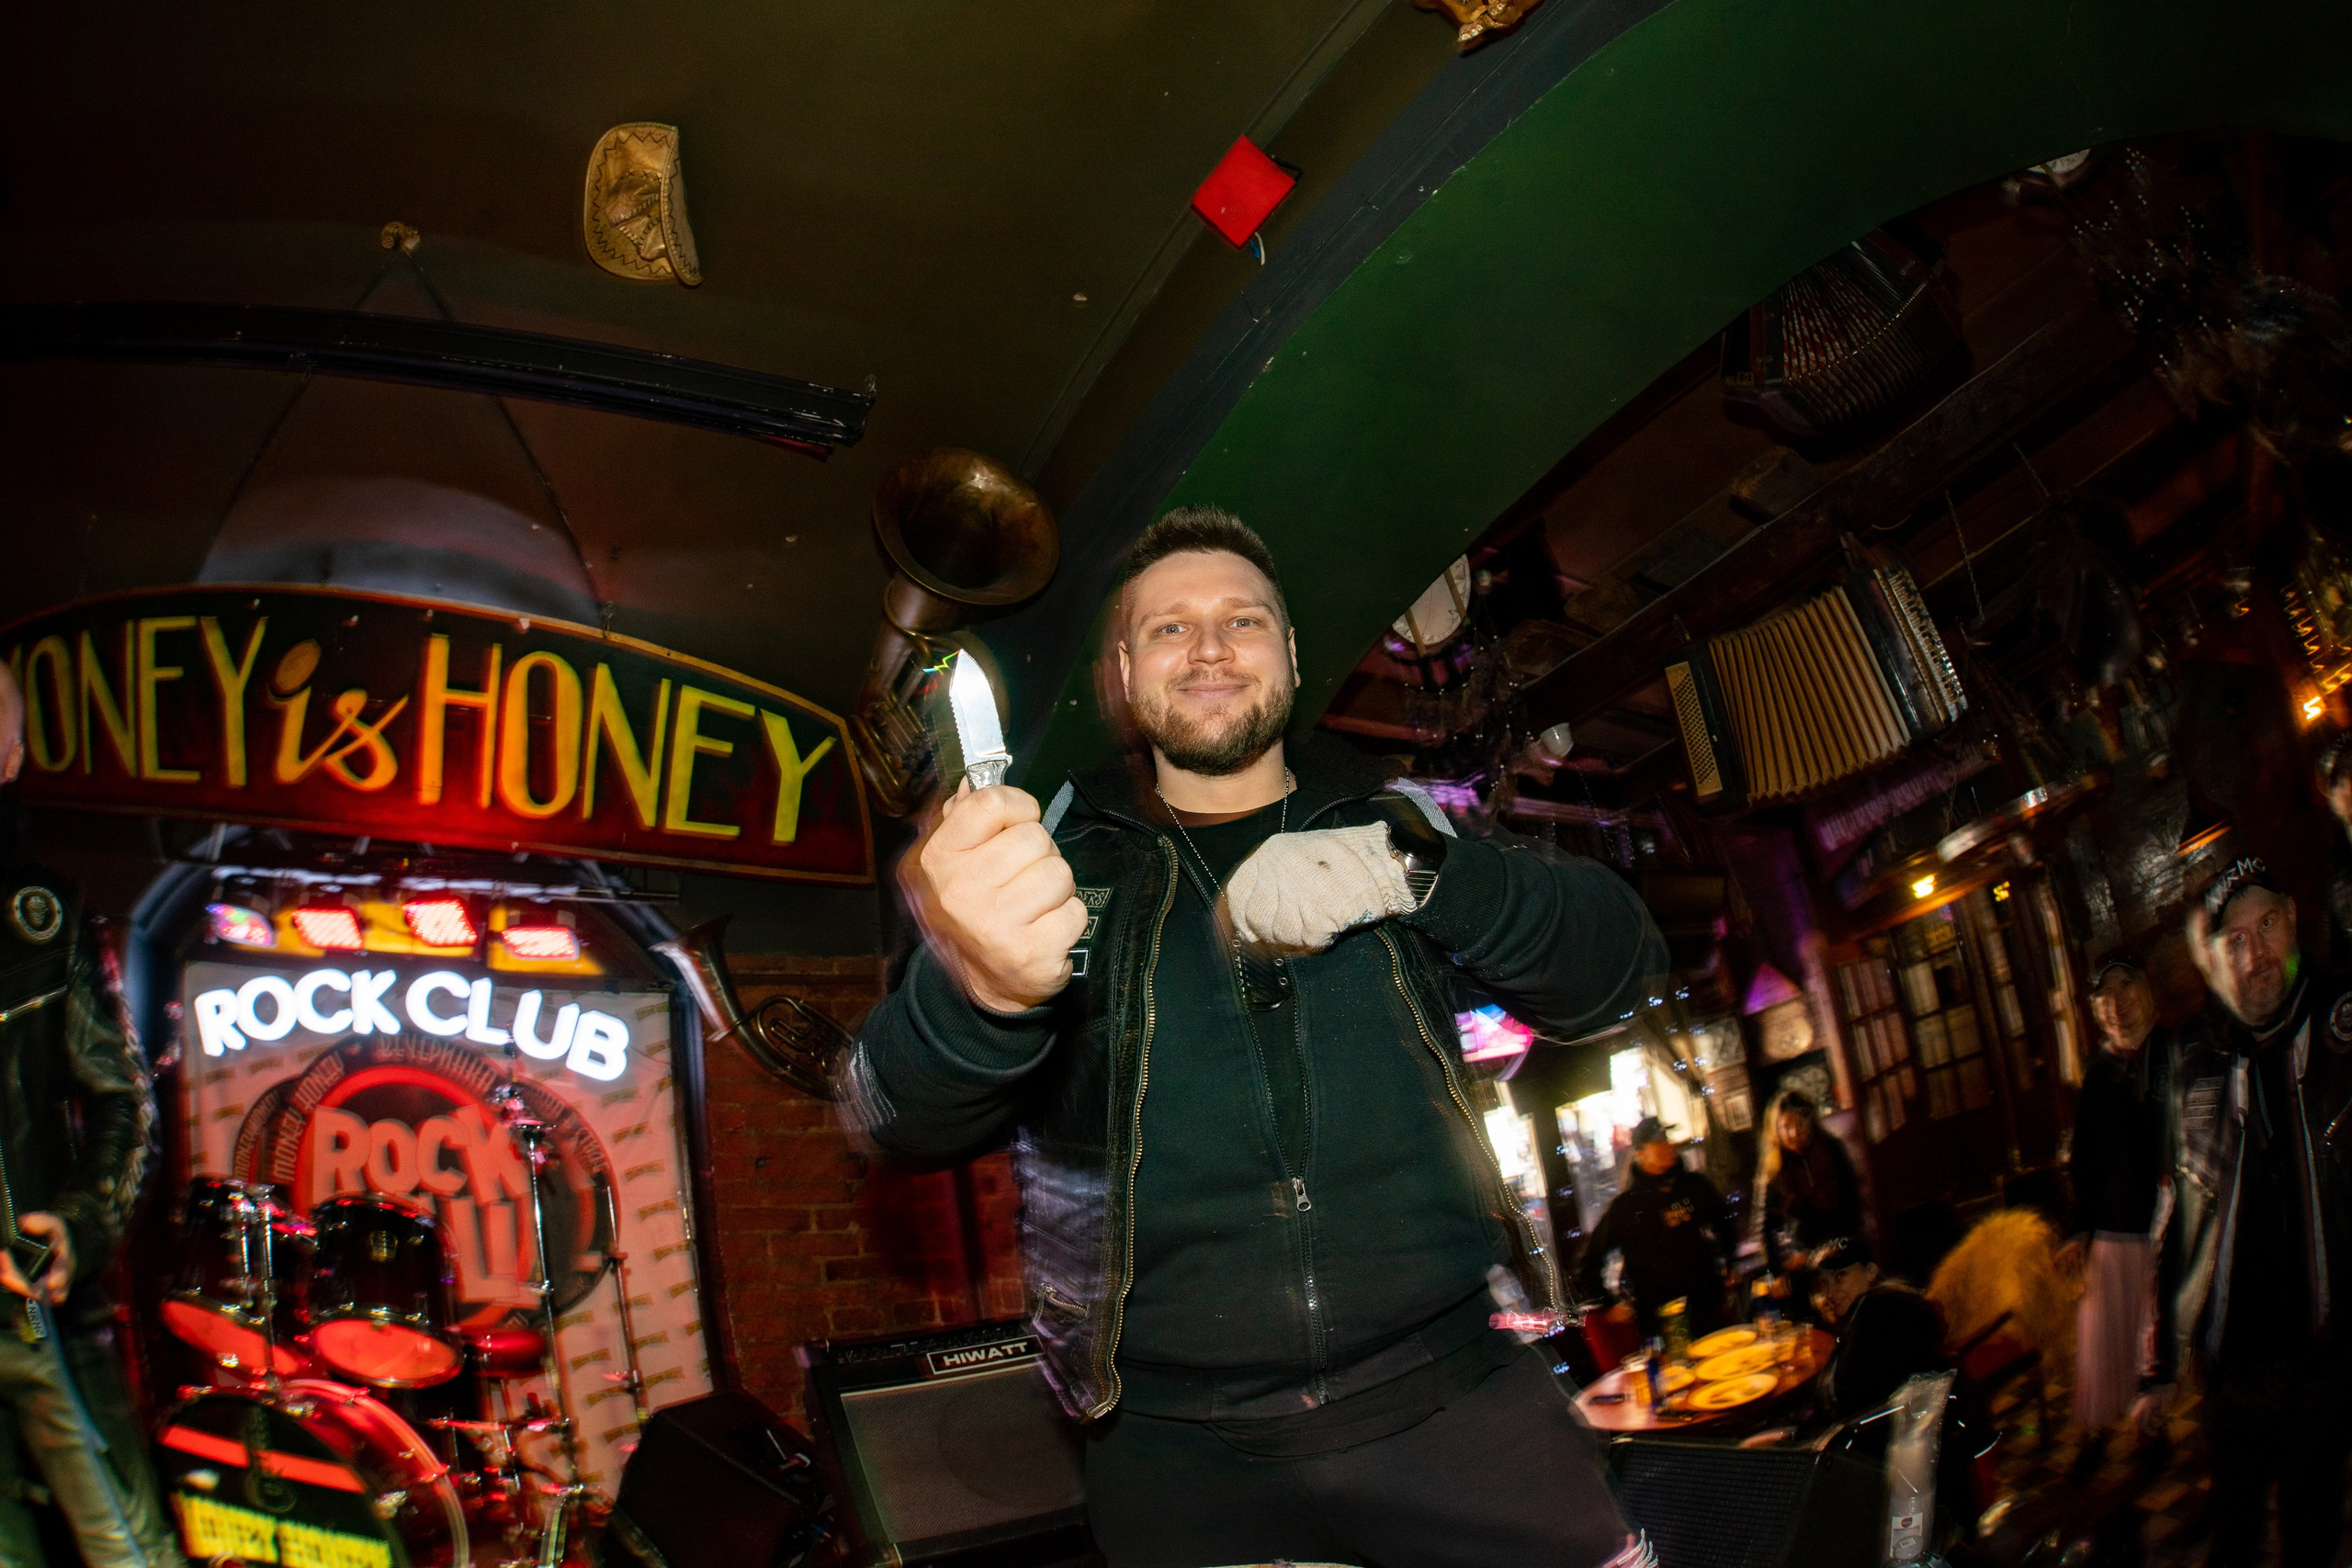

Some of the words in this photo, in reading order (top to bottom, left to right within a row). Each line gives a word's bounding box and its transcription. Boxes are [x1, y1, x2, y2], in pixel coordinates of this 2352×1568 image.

[9, 615, 269, 788] ONEY
[268, 638, 409, 792] is
[417, 633, 838, 847] HONEY
[195, 968, 401, 1056] ROCK
[405, 971, 630, 1081] CLUB
[312, 1104, 532, 1209] ROCK
[942, 1341, 1029, 1367] HIWATT
